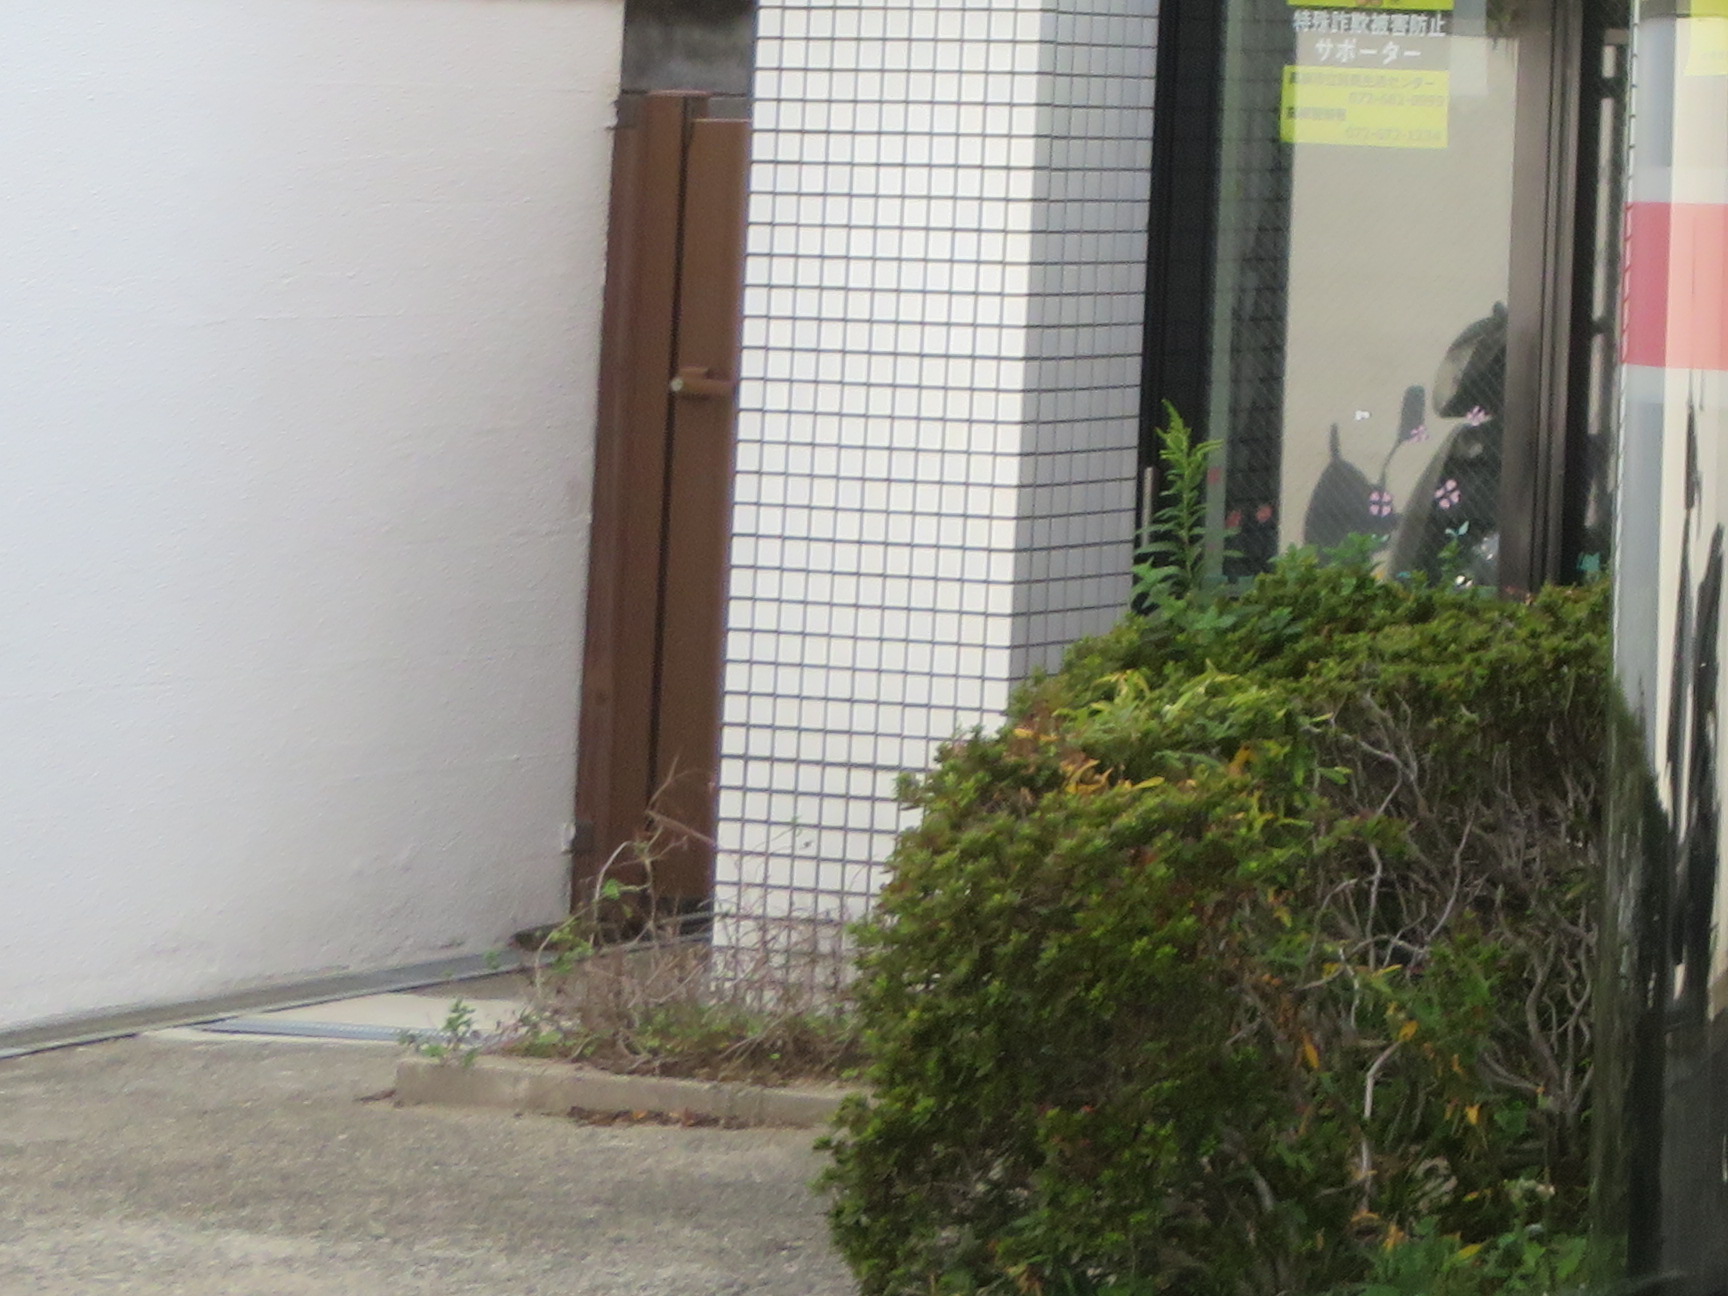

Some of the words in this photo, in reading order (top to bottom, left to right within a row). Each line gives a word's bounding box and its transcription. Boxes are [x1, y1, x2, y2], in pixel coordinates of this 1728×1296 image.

[1291, 9, 1447, 38] 特殊詐欺被害防止
[1314, 39, 1422, 64] サポーター
